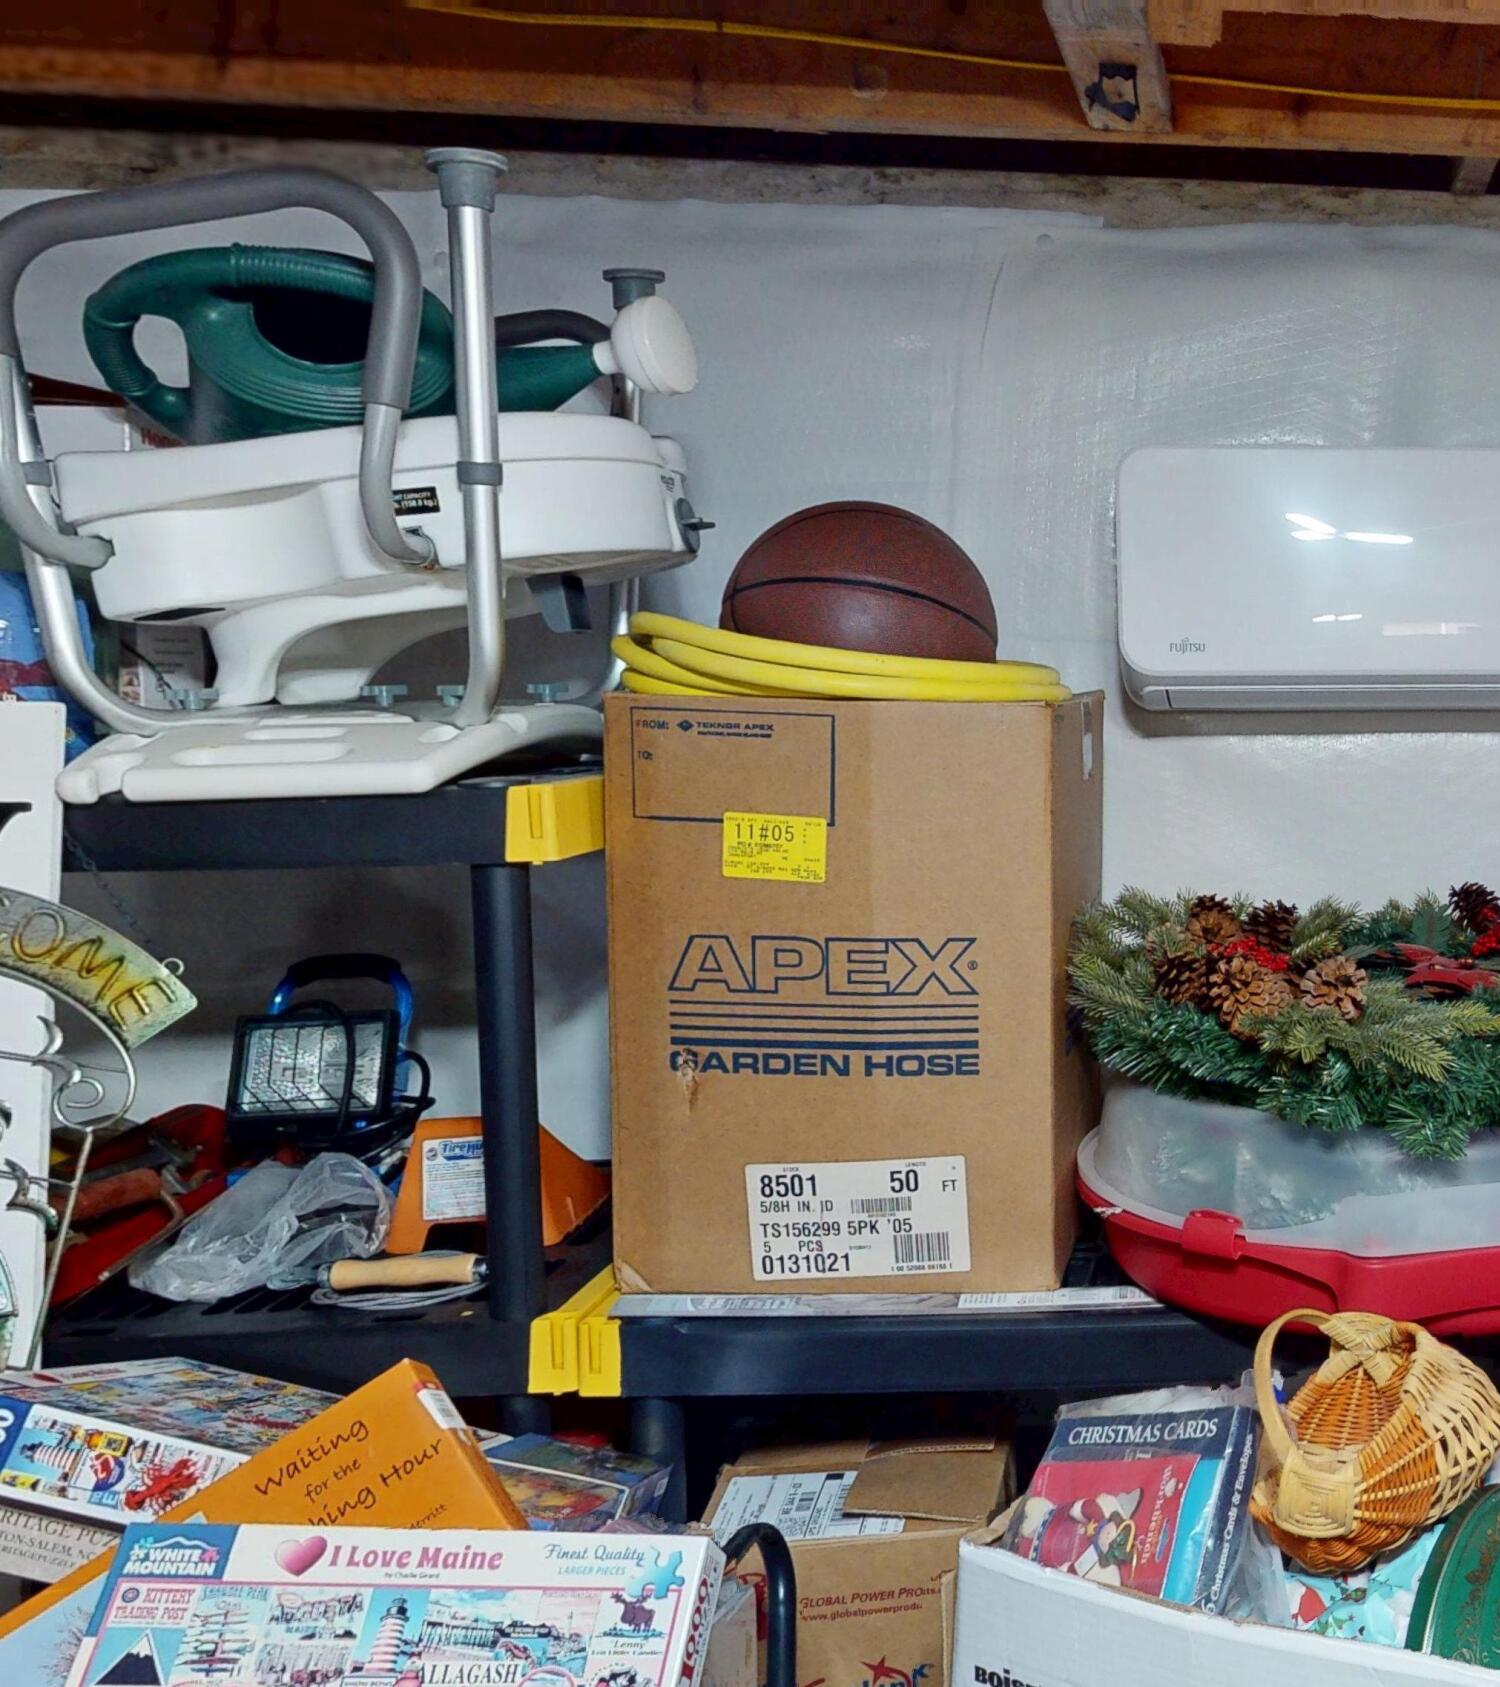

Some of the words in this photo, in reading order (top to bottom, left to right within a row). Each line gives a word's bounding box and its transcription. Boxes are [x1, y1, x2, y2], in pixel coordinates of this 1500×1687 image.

[635, 719, 670, 730] FROM:
[696, 720, 741, 730] TEKNOR
[744, 722, 775, 732] APEX
[637, 750, 653, 761] TO:
[736, 822, 795, 843] 11#05
[0, 896, 178, 1031] OME
[667, 934, 980, 996] APEX
[669, 1050, 850, 1077] GARDEN
[864, 1053, 980, 1077] HOSE
[760, 1174, 818, 1198] 8501
[889, 1168, 919, 1194] 50
[942, 1179, 958, 1192] FT
[759, 1200, 790, 1214] 5/8H
[820, 1199, 834, 1213] ID
[759, 1220, 841, 1239] TS156299
[847, 1219, 880, 1236] 5PK
[887, 1217, 913, 1234] '05
[763, 1240, 772, 1254] 5
[798, 1239, 824, 1253] PCS
[761, 1252, 851, 1275] 0131021
[1068, 1423, 1161, 1445] CHRISTMAS
[1163, 1418, 1218, 1441] CARDS
[254, 1419, 370, 1497] Waiting
[379, 1438, 442, 1488] Hour
[304, 1479, 330, 1504] for
[333, 1458, 362, 1481] the
[1210, 1540, 1232, 1601] Christmas
[1223, 1506, 1239, 1540] Cards
[1234, 1433, 1254, 1490] Envelopes
[150, 1548, 202, 1562] WHITE
[328, 1545, 342, 1567] I
[346, 1545, 413, 1569] Love
[416, 1544, 504, 1570] Maine
[544, 1543, 589, 1560] Finest
[594, 1544, 647, 1567] Quality
[122, 1561, 216, 1576] MOUNTAIN
[558, 1566, 594, 1576] LARGER
[596, 1566, 627, 1576] PIECES
[144, 1587, 196, 1604] KITTERY
[800, 1595, 847, 1609] GLOBAL
[851, 1590, 894, 1604] POWER
[161, 1607, 188, 1620] POST
[419, 1662, 519, 1686] ALLAGASH
